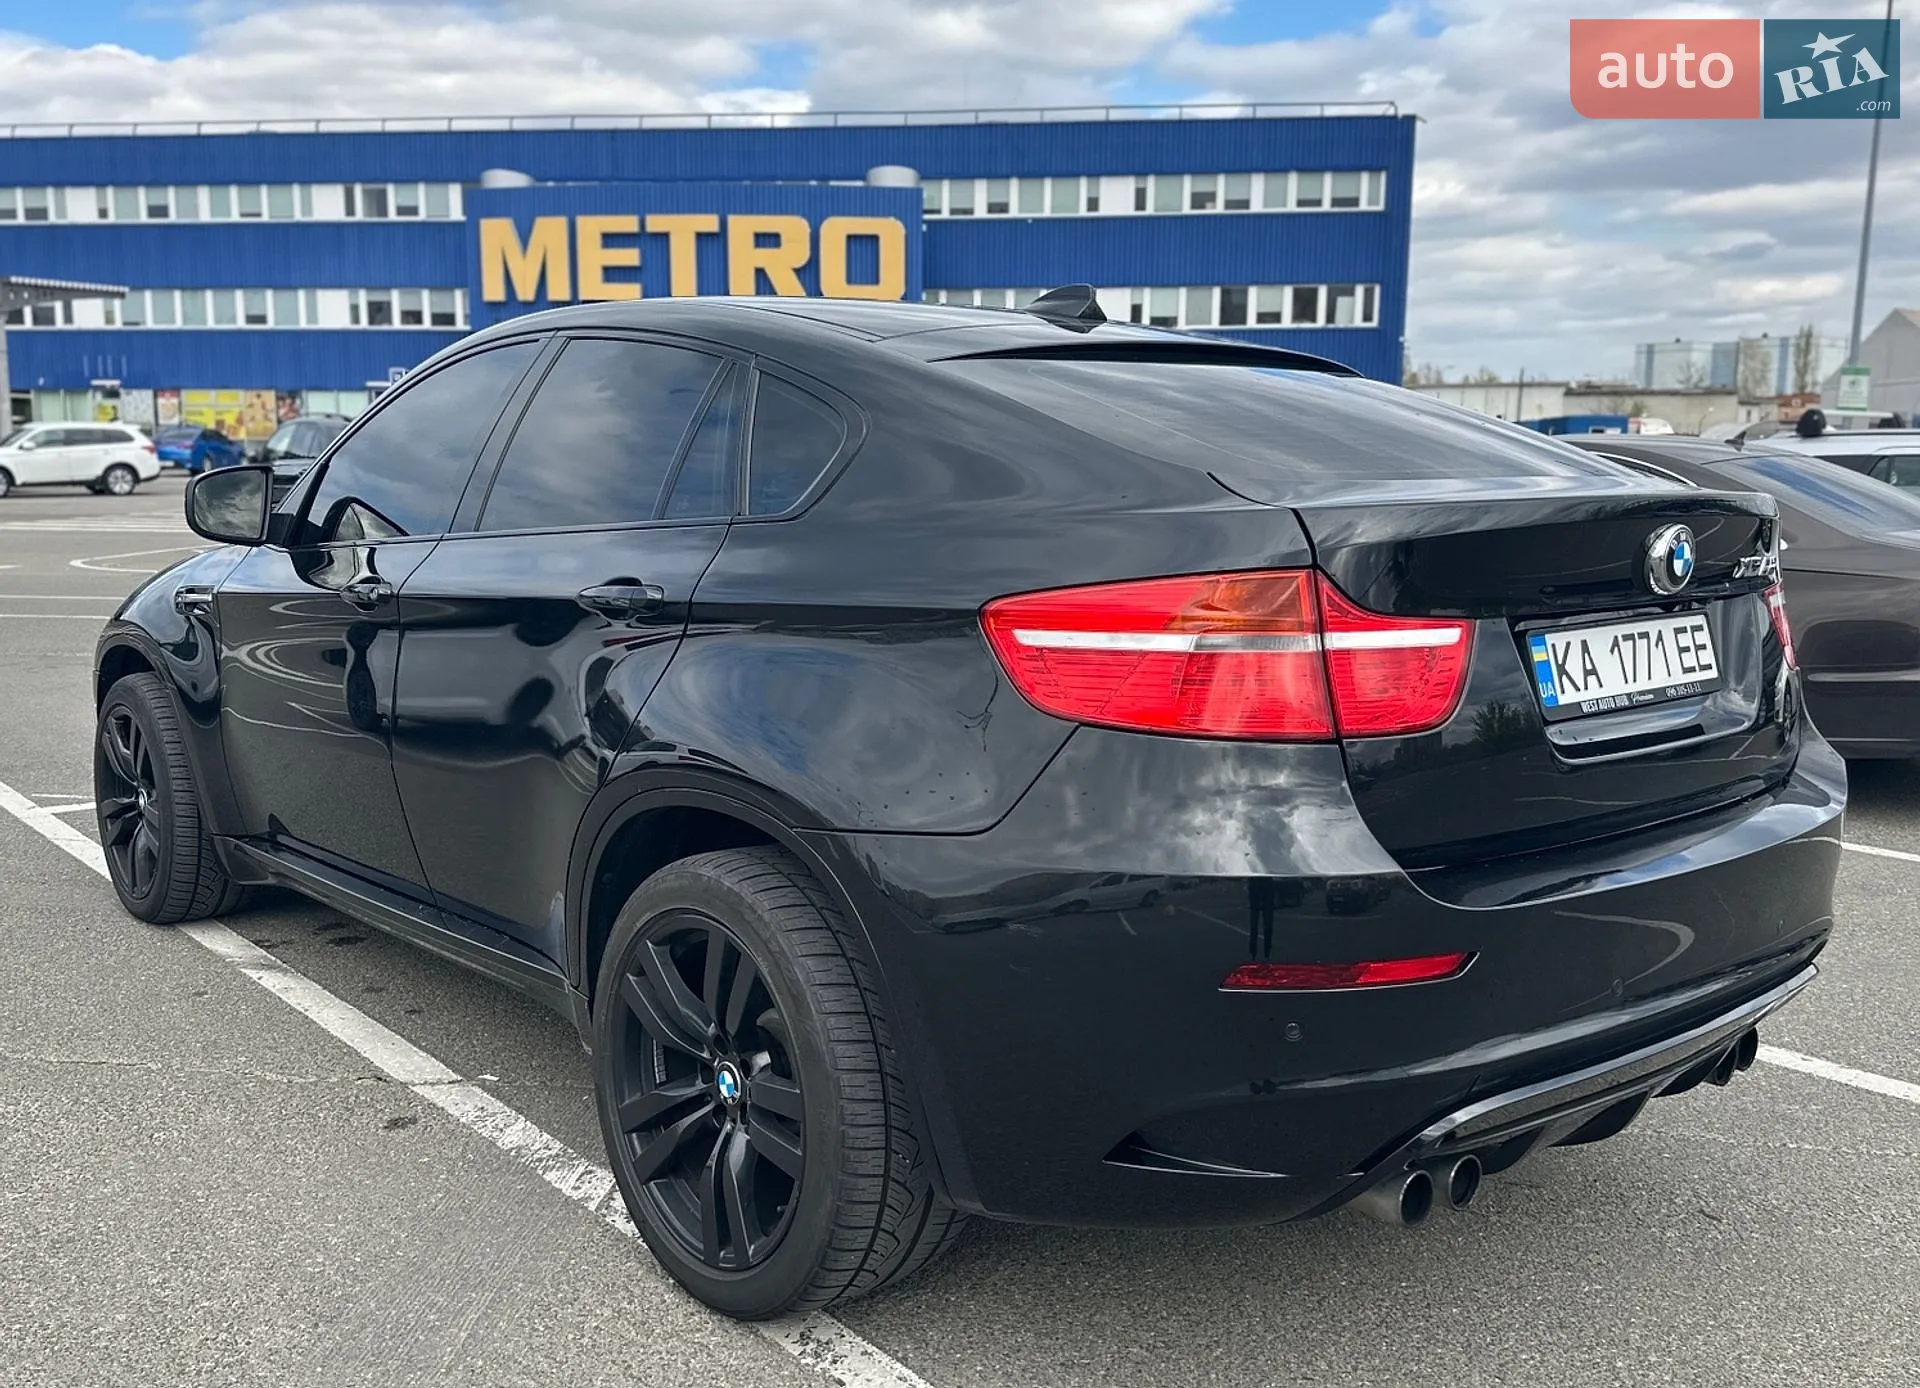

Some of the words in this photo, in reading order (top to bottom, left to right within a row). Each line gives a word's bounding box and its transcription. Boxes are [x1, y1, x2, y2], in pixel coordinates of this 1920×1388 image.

[479, 214, 906, 302] METRO
[1539, 681, 1556, 699] UA
[1551, 639, 1604, 695] KA
[1609, 629, 1671, 684] 1771
[1673, 624, 1713, 675] EE
